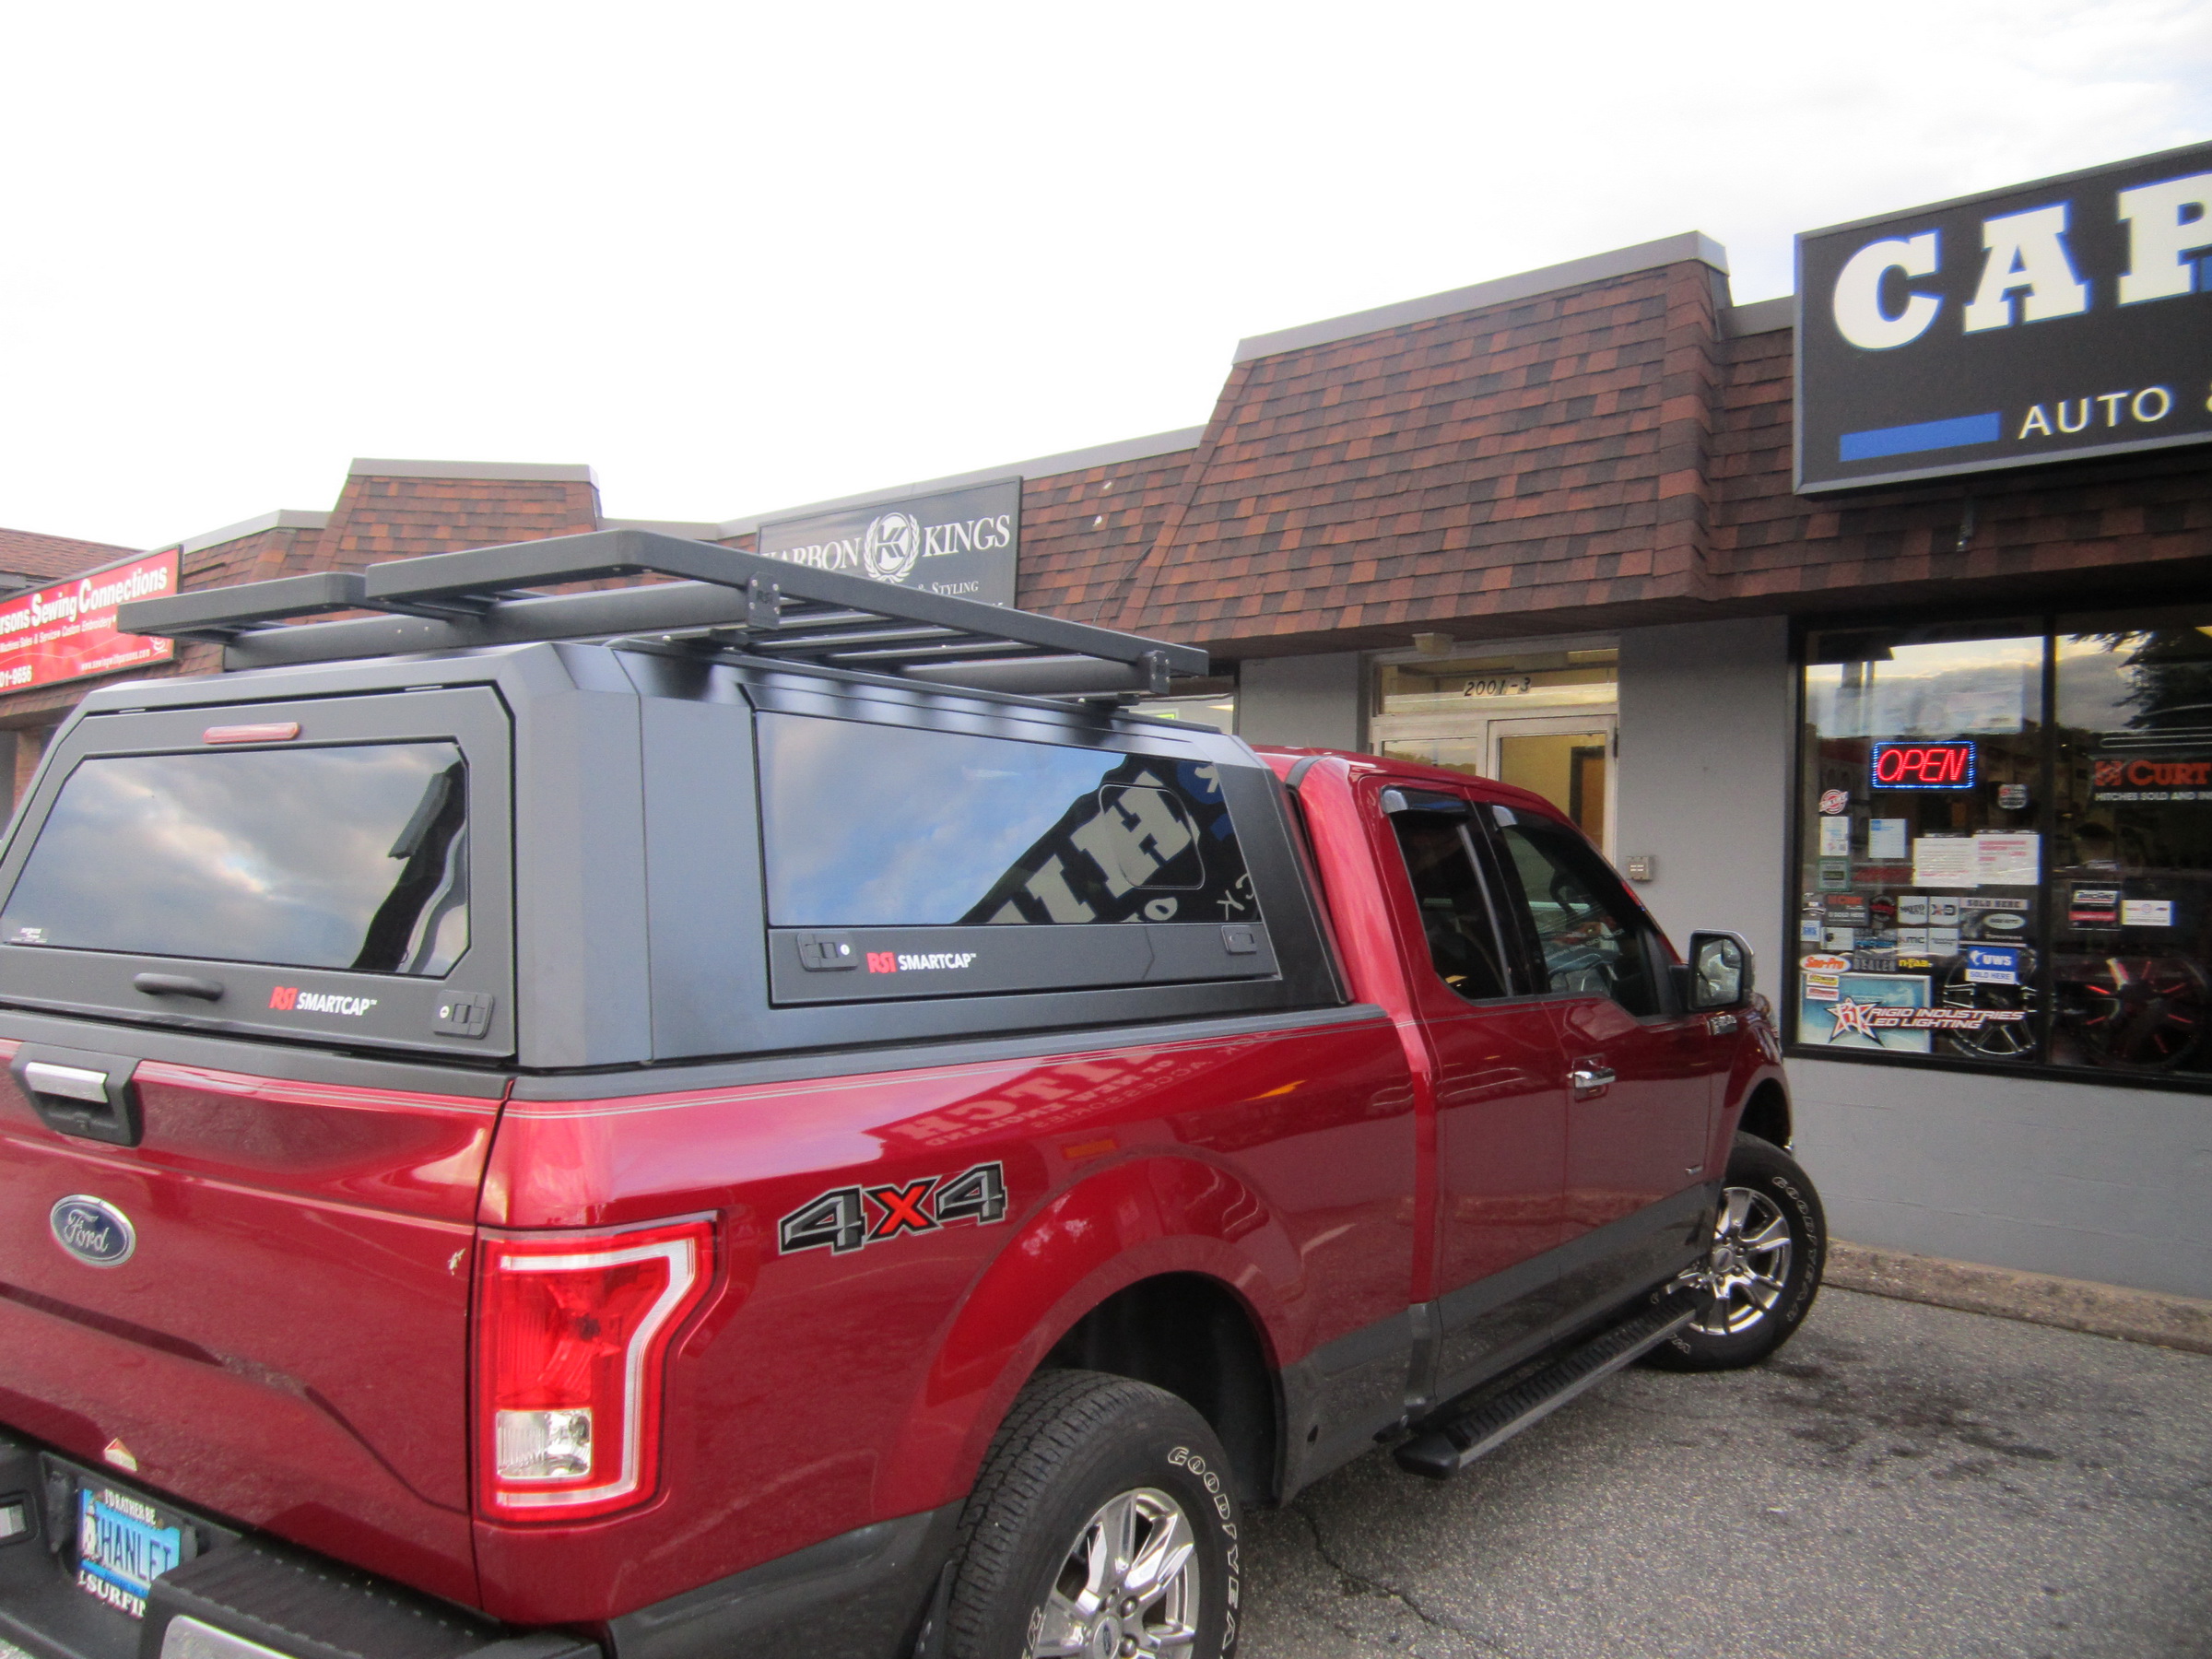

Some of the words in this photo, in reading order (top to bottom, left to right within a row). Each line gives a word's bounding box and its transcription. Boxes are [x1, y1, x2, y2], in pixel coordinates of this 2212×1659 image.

[2018, 386, 2172, 440] AUTO
[761, 537, 862, 571] RBON
[923, 514, 1010, 558] KINGS
[31, 593, 77, 627] Sewing
[79, 568, 168, 613] Connections
[932, 581, 979, 595] STYLING
[1464, 677, 1531, 697] 2001-3
[1877, 747, 1969, 782] OPEN
[2127, 760, 2211, 786] CURT
[2140, 792, 2169, 801] SOLD
[1983, 954, 2013, 966] UWS
[1970, 971, 1989, 979] SOLD
[1991, 971, 2011, 980] HERE
[1865, 1017, 1900, 1028] LED
[1900, 1018, 1983, 1030] LIGHTING
[1868, 1006, 1912, 1018] RIGID
[1916, 1007, 2026, 1021] INDUSTRIES
[65, 1208, 110, 1253] Ford
[1167, 1447, 1240, 1659] GOODYEA
